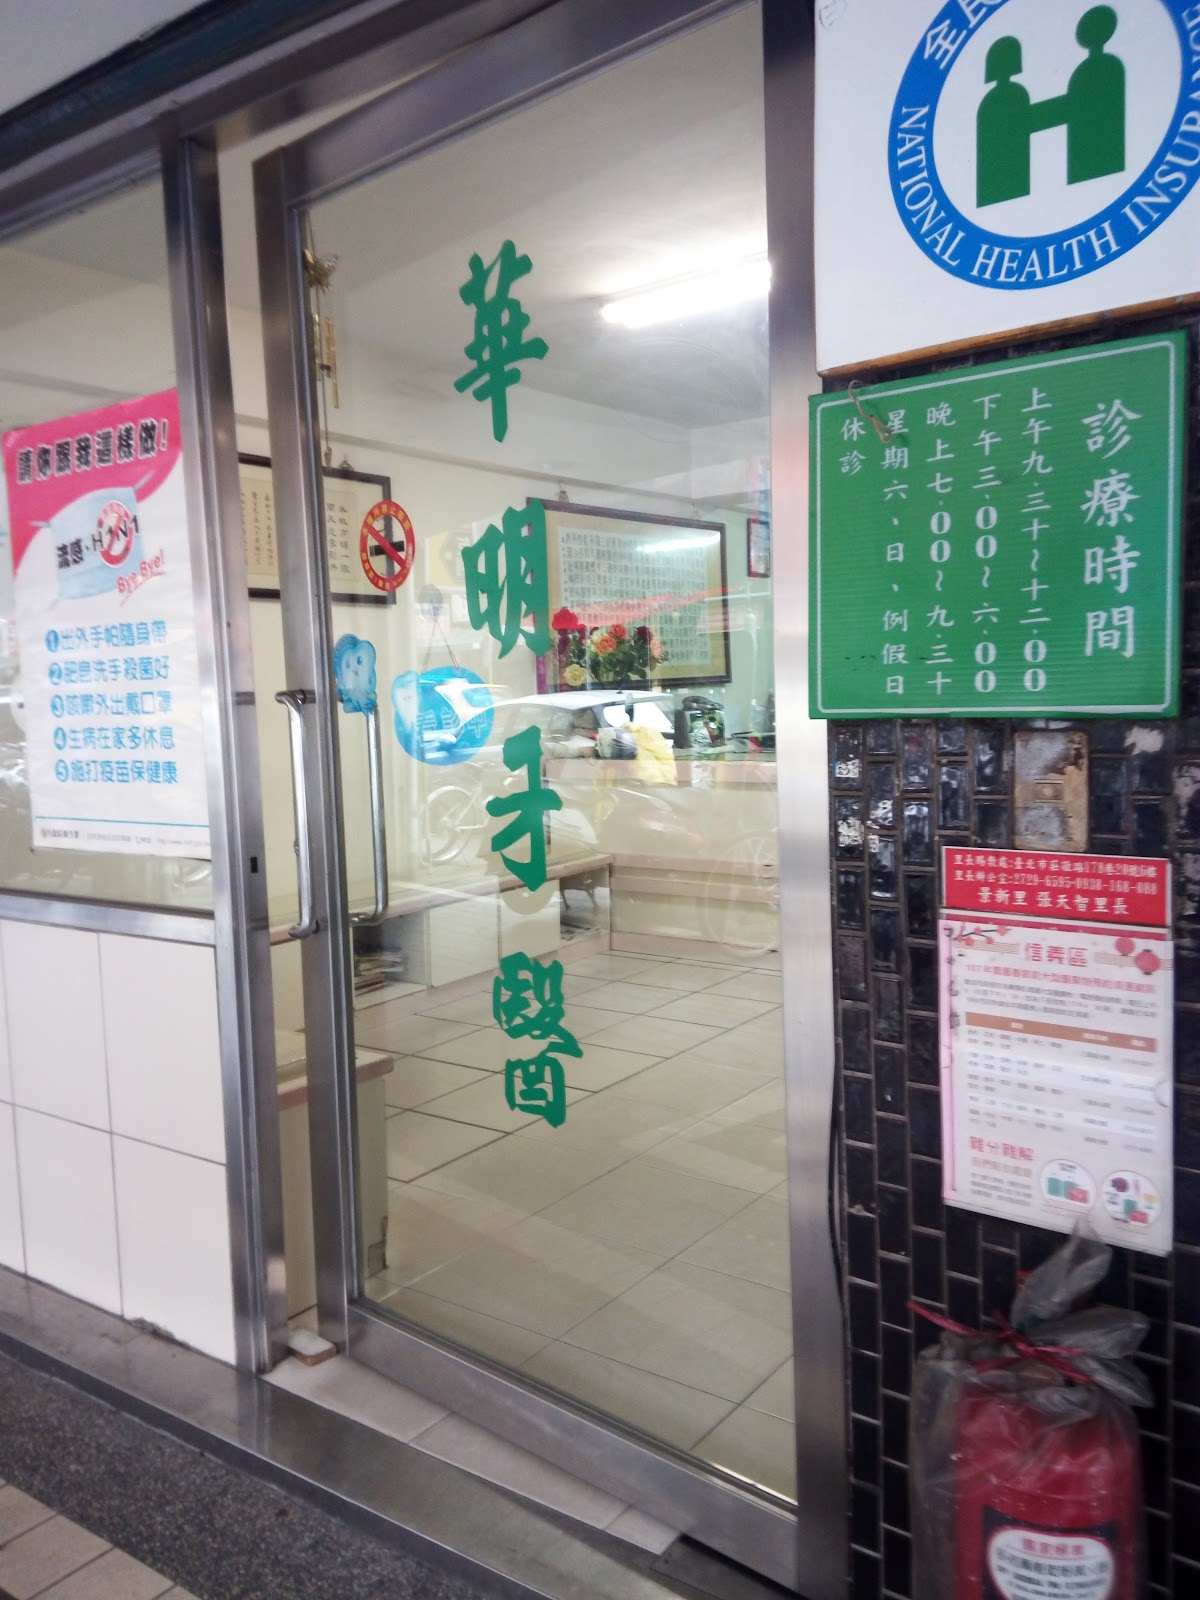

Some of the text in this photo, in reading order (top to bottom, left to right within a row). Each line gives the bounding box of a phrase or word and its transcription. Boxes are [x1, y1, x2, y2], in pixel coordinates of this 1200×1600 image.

[896, 105, 966, 267] NATIONAL
[970, 219, 1121, 283] HEALTH
[838, 418, 867, 477] 休診
[1080, 399, 1144, 659] 診療時間
[976, 886, 1029, 906] 景新里
